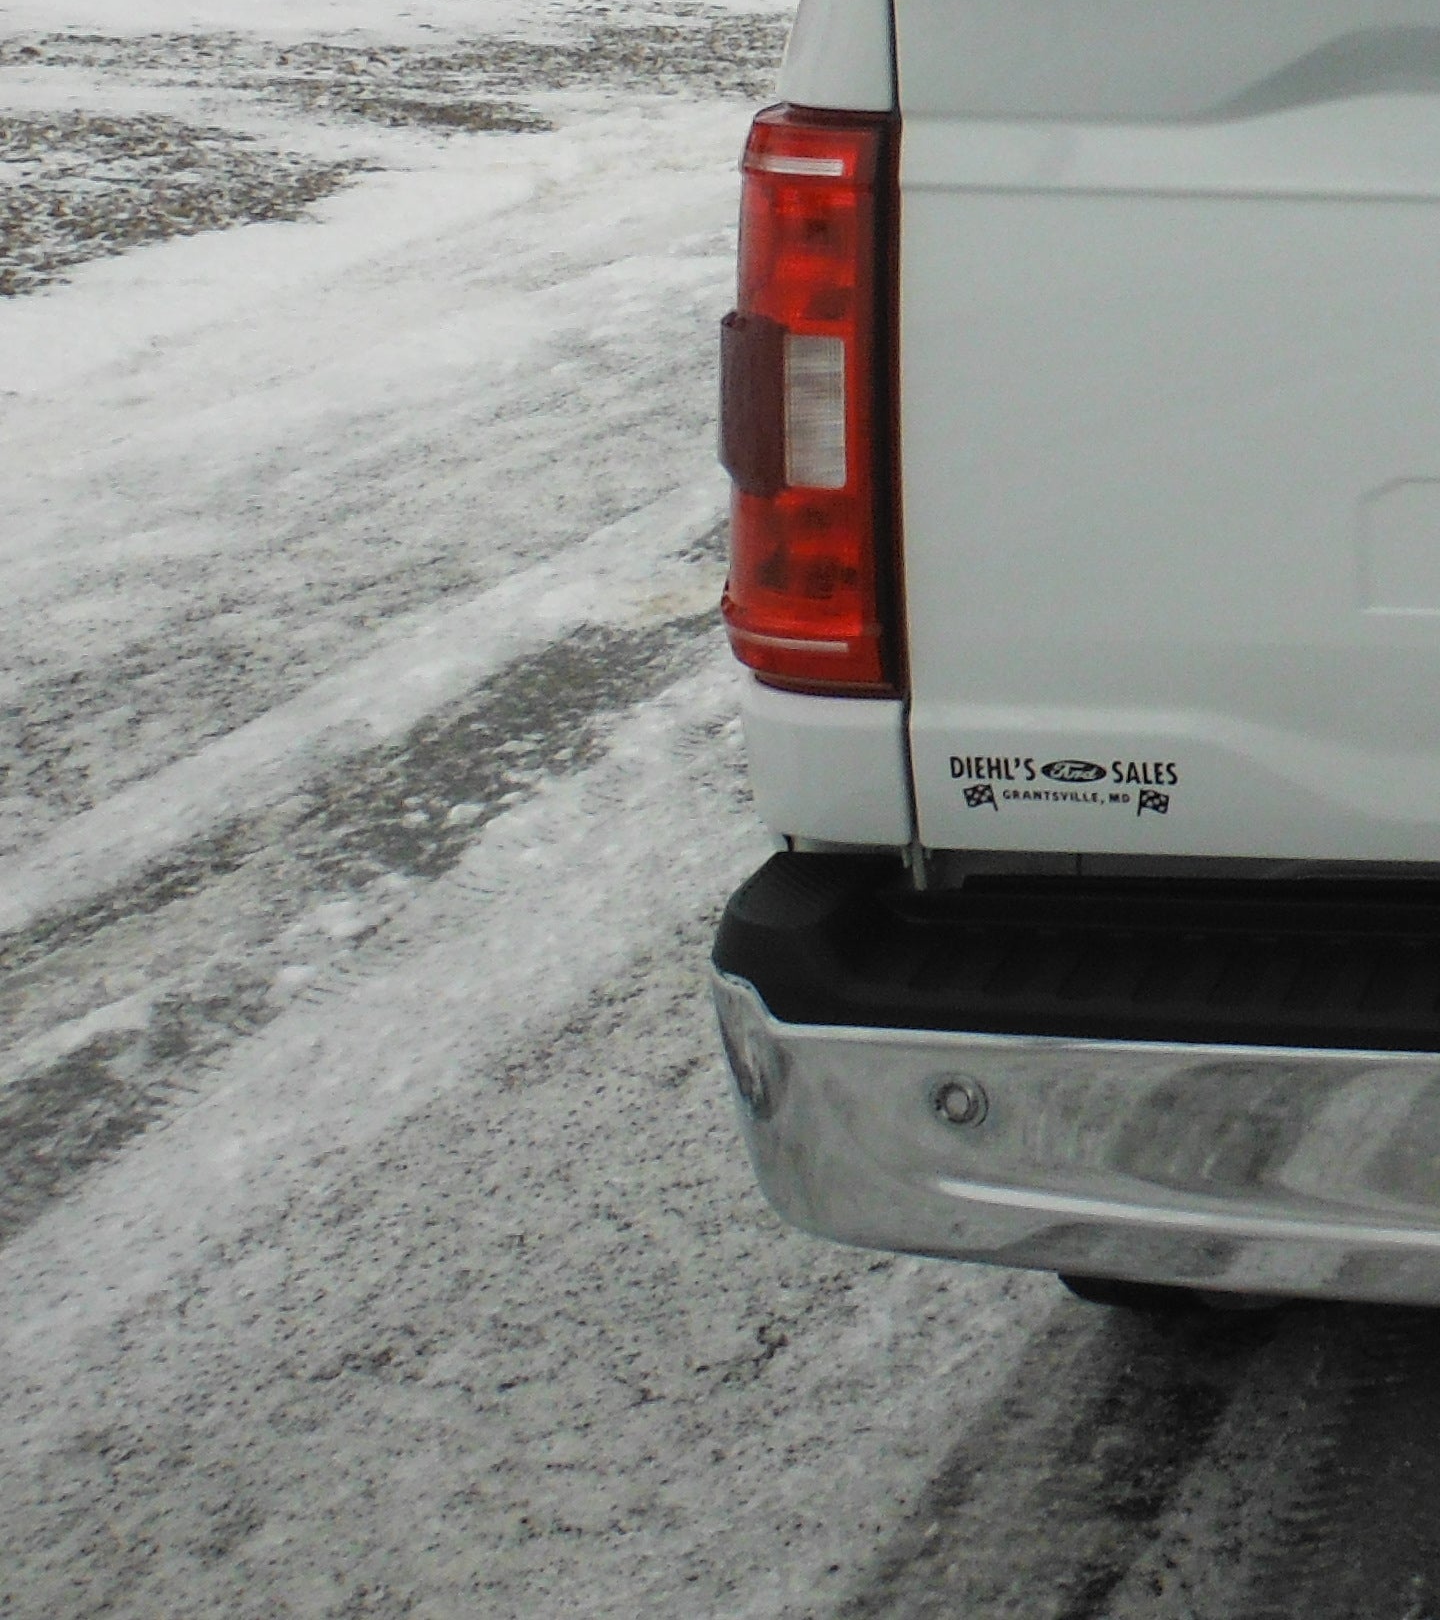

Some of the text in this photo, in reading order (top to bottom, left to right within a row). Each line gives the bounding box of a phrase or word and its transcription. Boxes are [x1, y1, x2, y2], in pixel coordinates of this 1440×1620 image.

[950, 755, 1037, 780] DIEHL'S
[1112, 760, 1179, 785] SALES
[1002, 789, 1131, 806] GRANTSVILLE, MD
